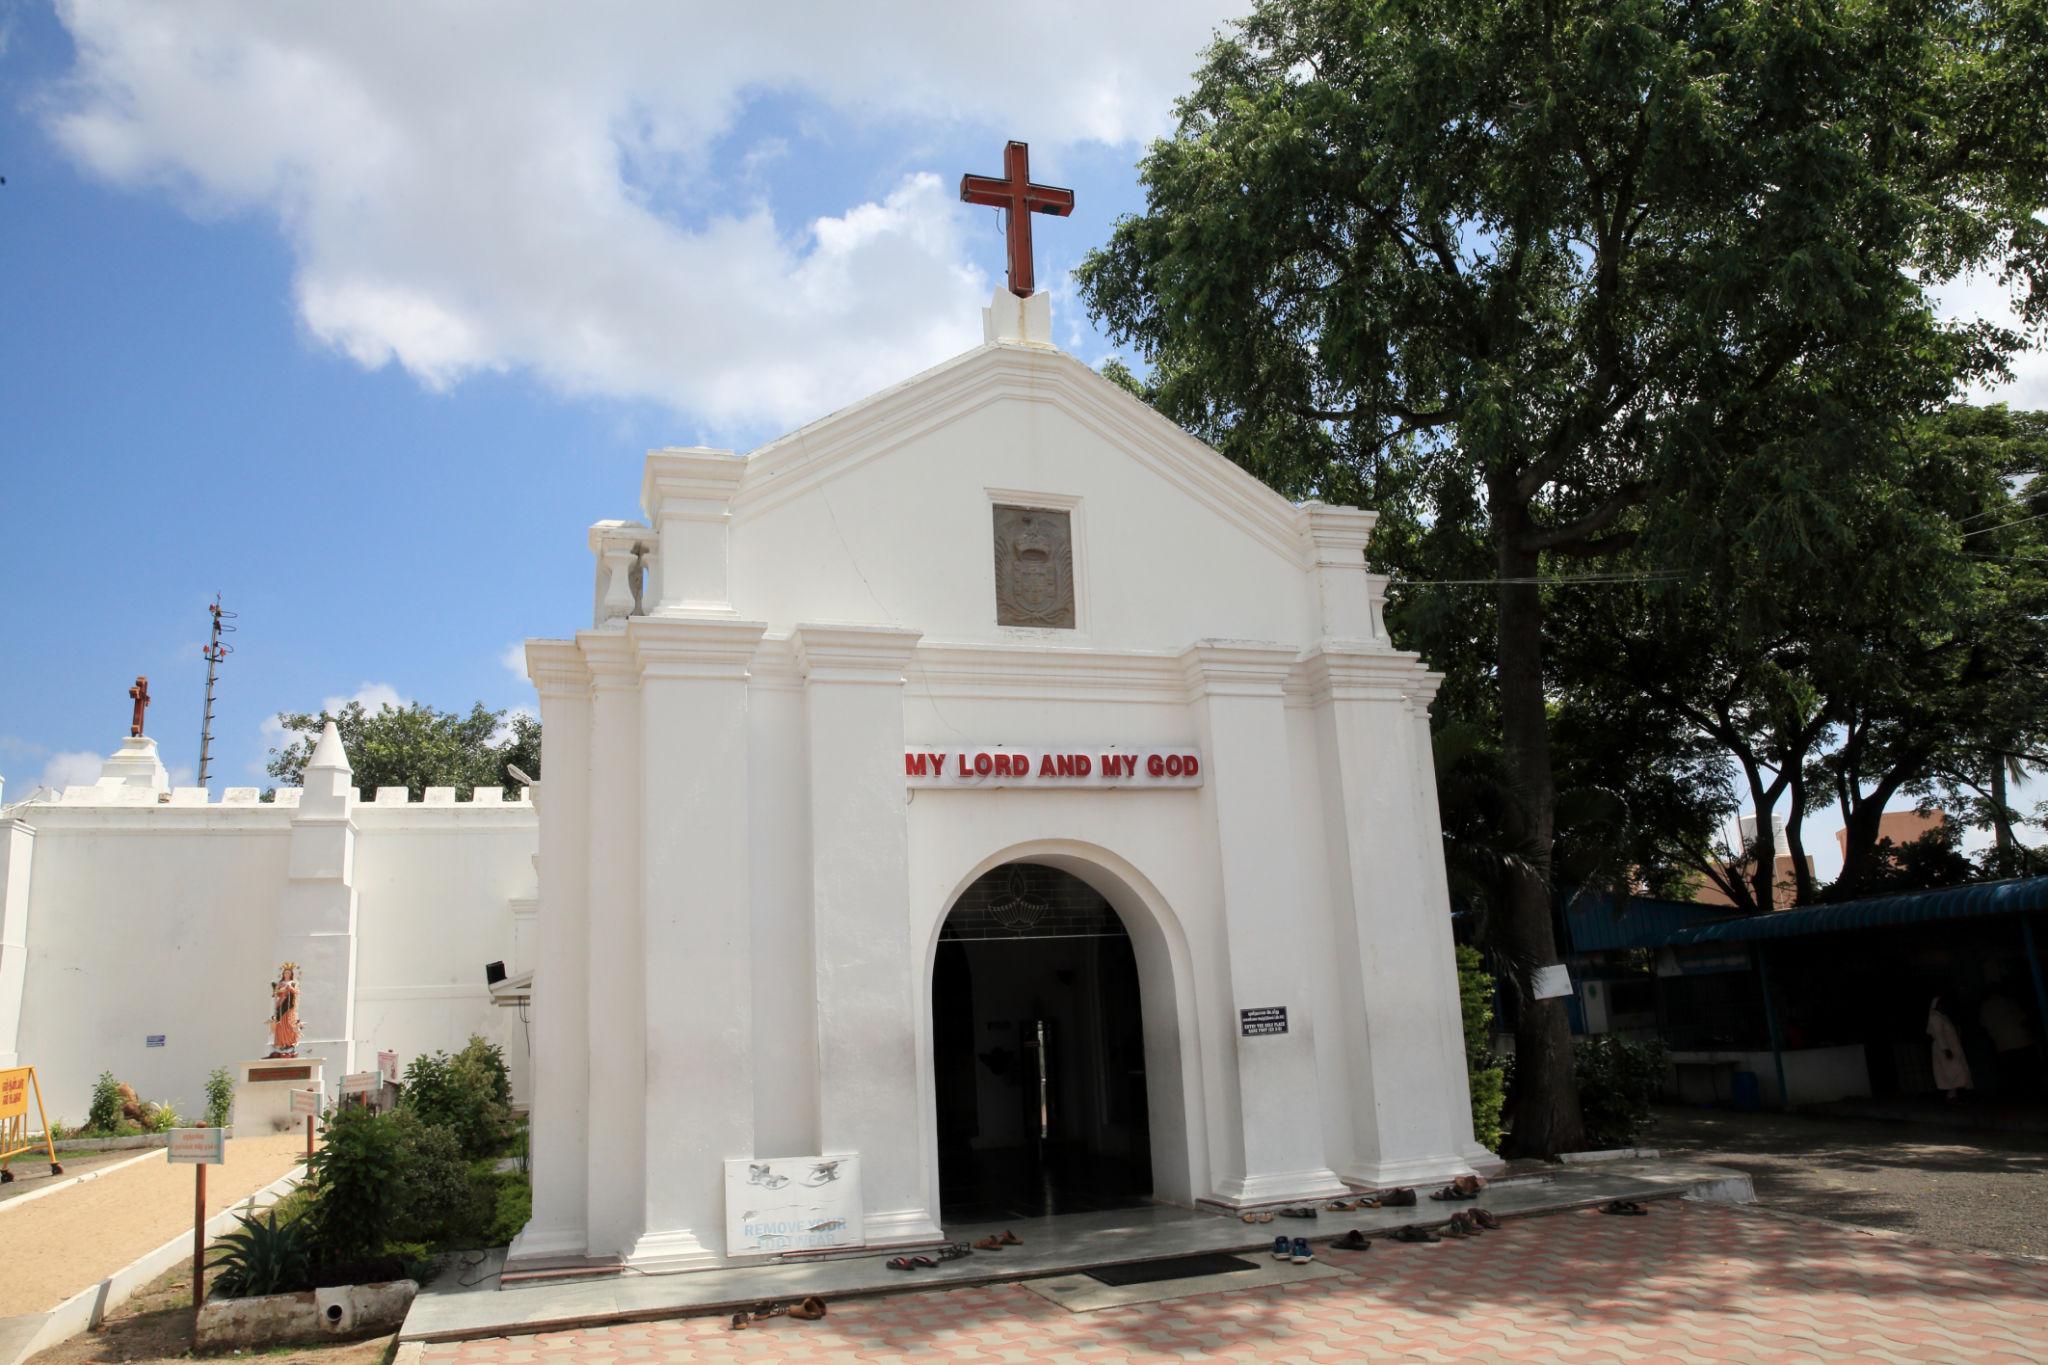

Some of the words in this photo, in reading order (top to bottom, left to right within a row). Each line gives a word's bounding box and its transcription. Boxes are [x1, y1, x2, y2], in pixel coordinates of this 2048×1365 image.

[905, 753, 946, 777] MY
[958, 753, 1030, 777] LORD
[1038, 754, 1092, 777] AND
[1101, 754, 1139, 777] MY
[1147, 754, 1199, 777] GOD
